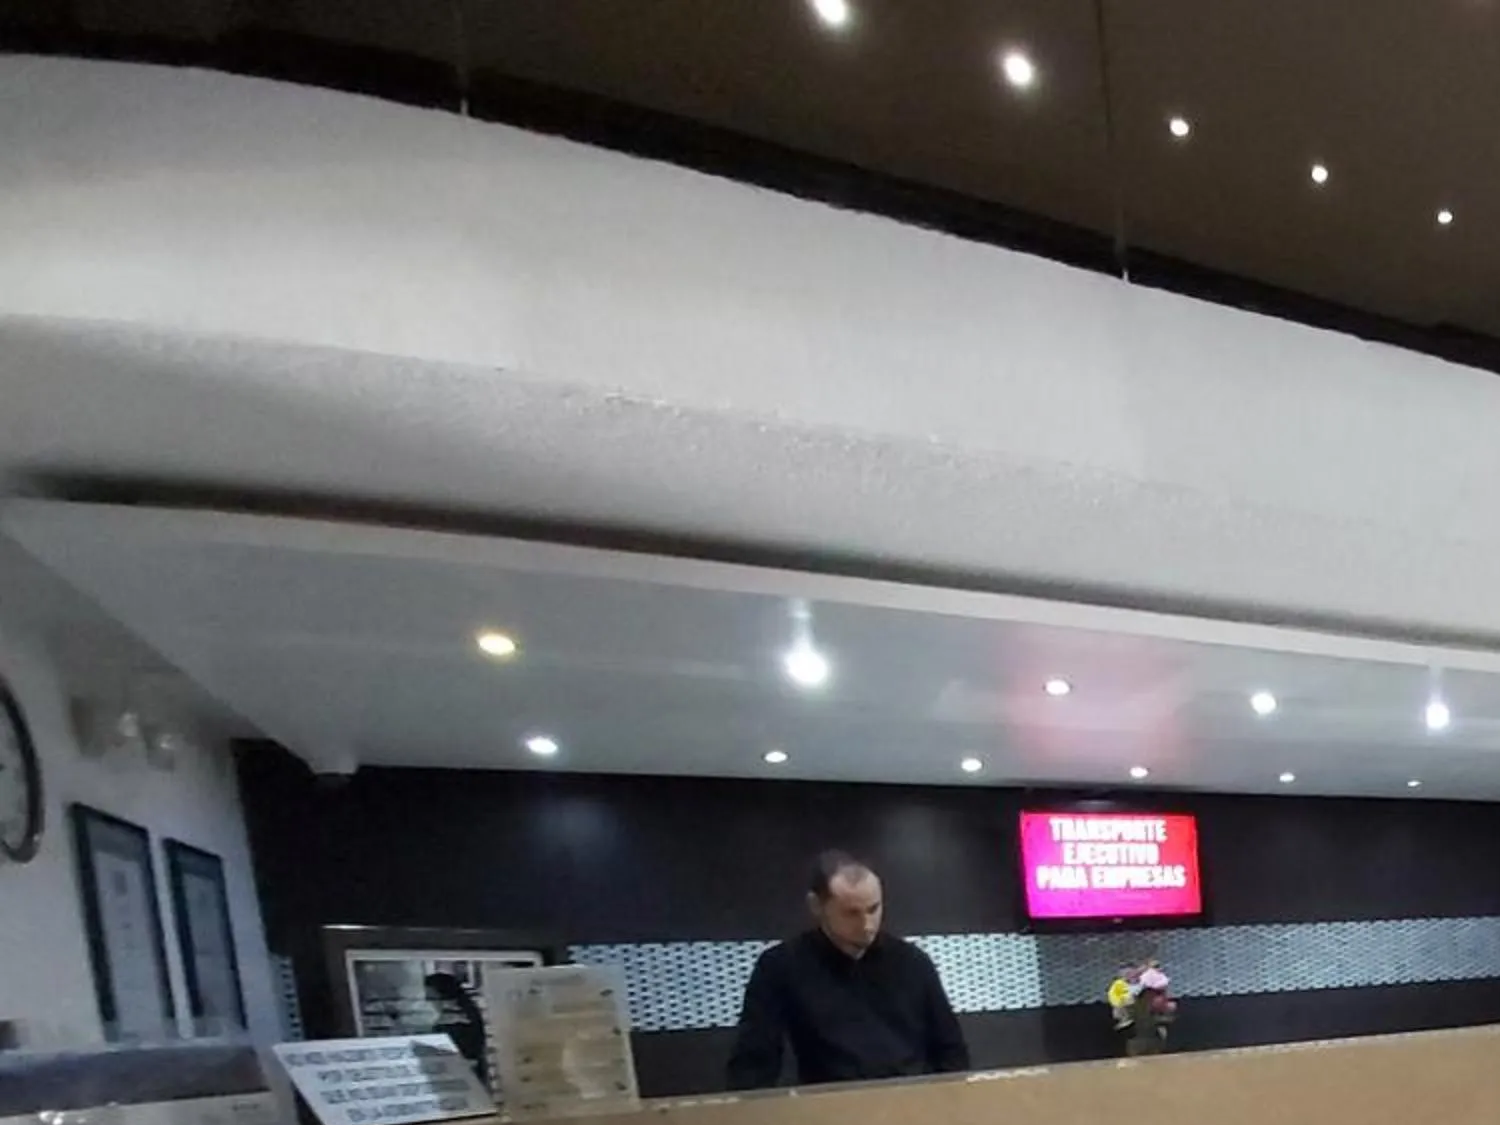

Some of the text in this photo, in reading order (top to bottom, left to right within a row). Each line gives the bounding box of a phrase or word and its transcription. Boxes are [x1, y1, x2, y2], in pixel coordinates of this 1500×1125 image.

[1049, 817, 1167, 841] TRANSPORTE
[1036, 865, 1186, 889] PARA EMPRESAS
